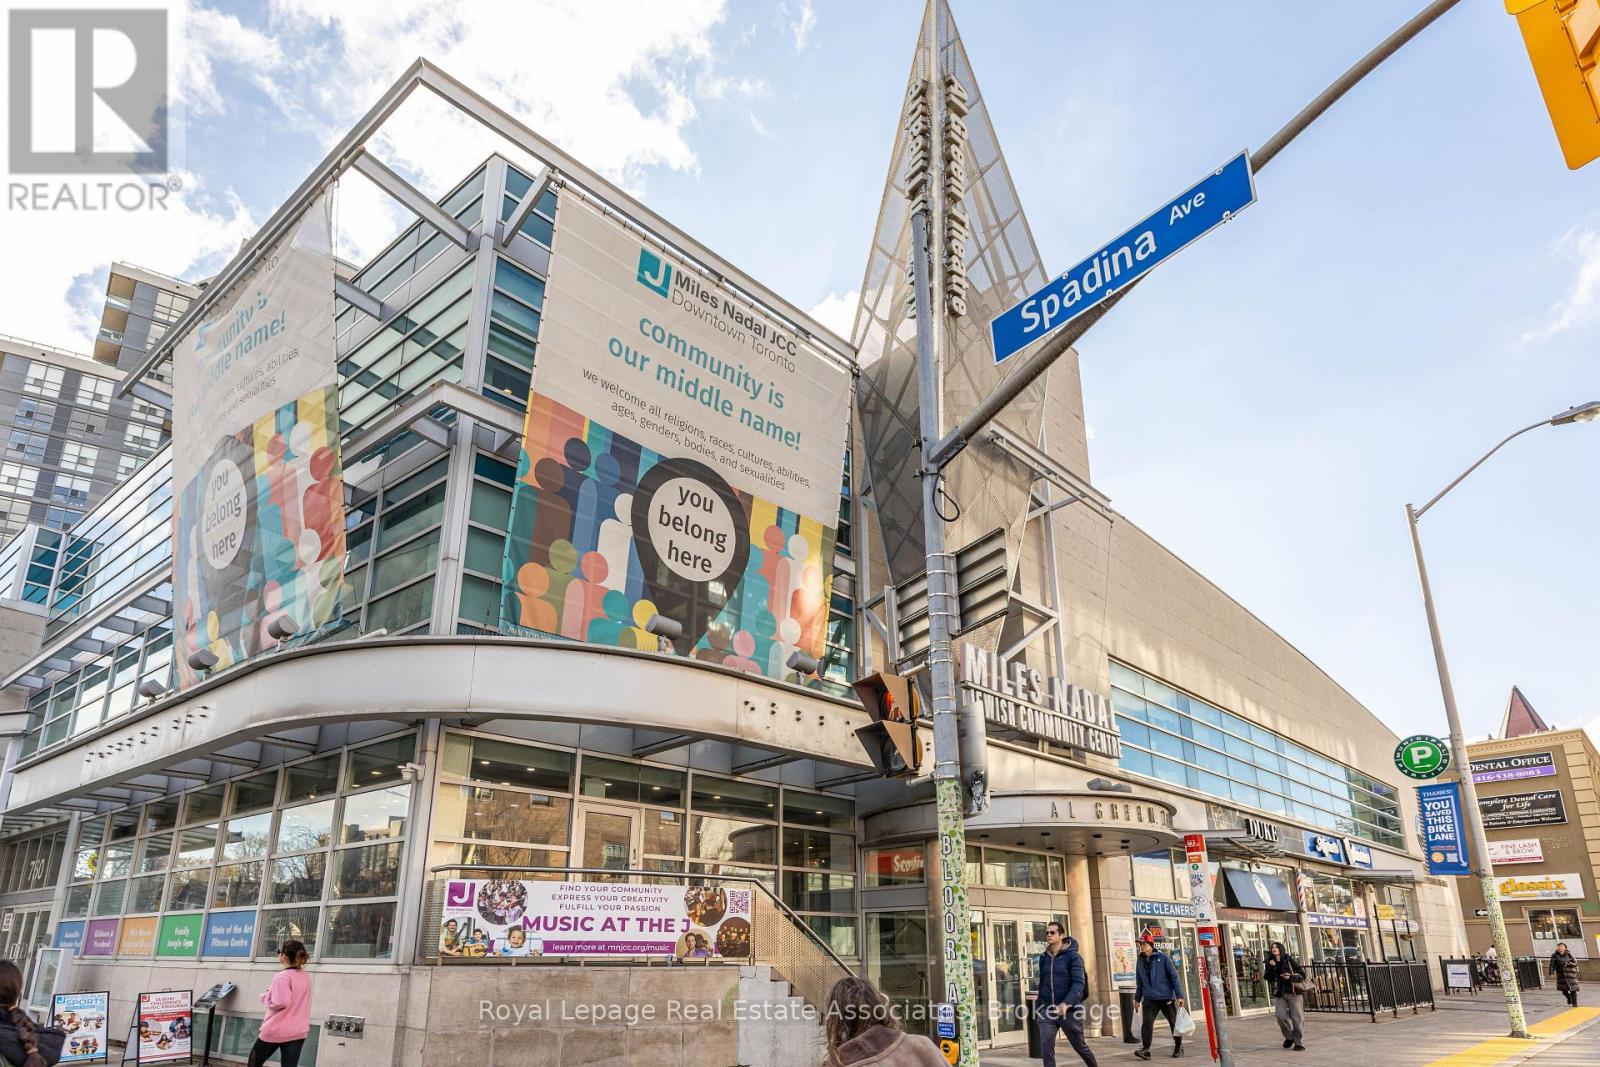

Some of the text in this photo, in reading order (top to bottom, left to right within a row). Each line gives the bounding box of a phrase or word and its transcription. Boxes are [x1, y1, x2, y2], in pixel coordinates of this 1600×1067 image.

[946, 73, 969, 317] Al Green Theatre
[1020, 191, 1206, 333] Spadina Ave
[675, 271, 797, 356] Miles Nadal JCC
[672, 289, 795, 372] Downtown Toronto
[639, 317, 784, 408] community is
[608, 337, 801, 450] our middle name!
[583, 368, 811, 488] we welcome all religions, races, cultures, abilities,
[611, 401, 785, 490] ages, genders, bodies, and sexualities
[211, 469, 229, 500] you
[678, 486, 714, 514] you
[205, 491, 242, 533] belong
[659, 504, 728, 553] belong
[668, 540, 712, 574] here
[961, 642, 1120, 733] MILES NADAL
[1019, 706, 1086, 750] COMMUNITY
[1396, 737, 1446, 758] MUNICIPAL
[1411, 746, 1432, 764] P
[1397, 759, 1448, 778] PARKING
[1469, 756, 1551, 771] DENTAL OFFICE
[1421, 788, 1453, 798] THANKS!
[1510, 793, 1536, 803] Dental
[1537, 792, 1556, 800] Care
[1051, 801, 1075, 819] AL
[1095, 801, 1156, 824] GREEN
[1424, 799, 1450, 811] YOU
[1425, 809, 1452, 818] SAVED
[1500, 802, 1514, 812] for
[1516, 800, 1531, 809] Life
[1249, 819, 1278, 841] DUKE
[1426, 815, 1453, 826] THIS
[1428, 824, 1455, 834] BIKE
[1429, 833, 1456, 842] LANE
[584, 885, 608, 893] YOUR
[611, 886, 663, 894] COMMUNITY
[621, 895, 669, 903] CREATIVITY
[941, 834, 957, 960] BLOOR
[559, 903, 595, 911] FULFILL
[625, 904, 661, 912] PASSION
[1153, 903, 1195, 916] CLEANERS
[211, 924, 253, 935] State of the Art
[521, 915, 691, 934] MUSIC AT THE J
[211, 938, 229, 947] Fitness
[552, 943, 574, 951] learn
[597, 943, 606, 951] at
[608, 943, 670, 952] mnjcc.org/music
[66, 998, 105, 1006] SPORTS
